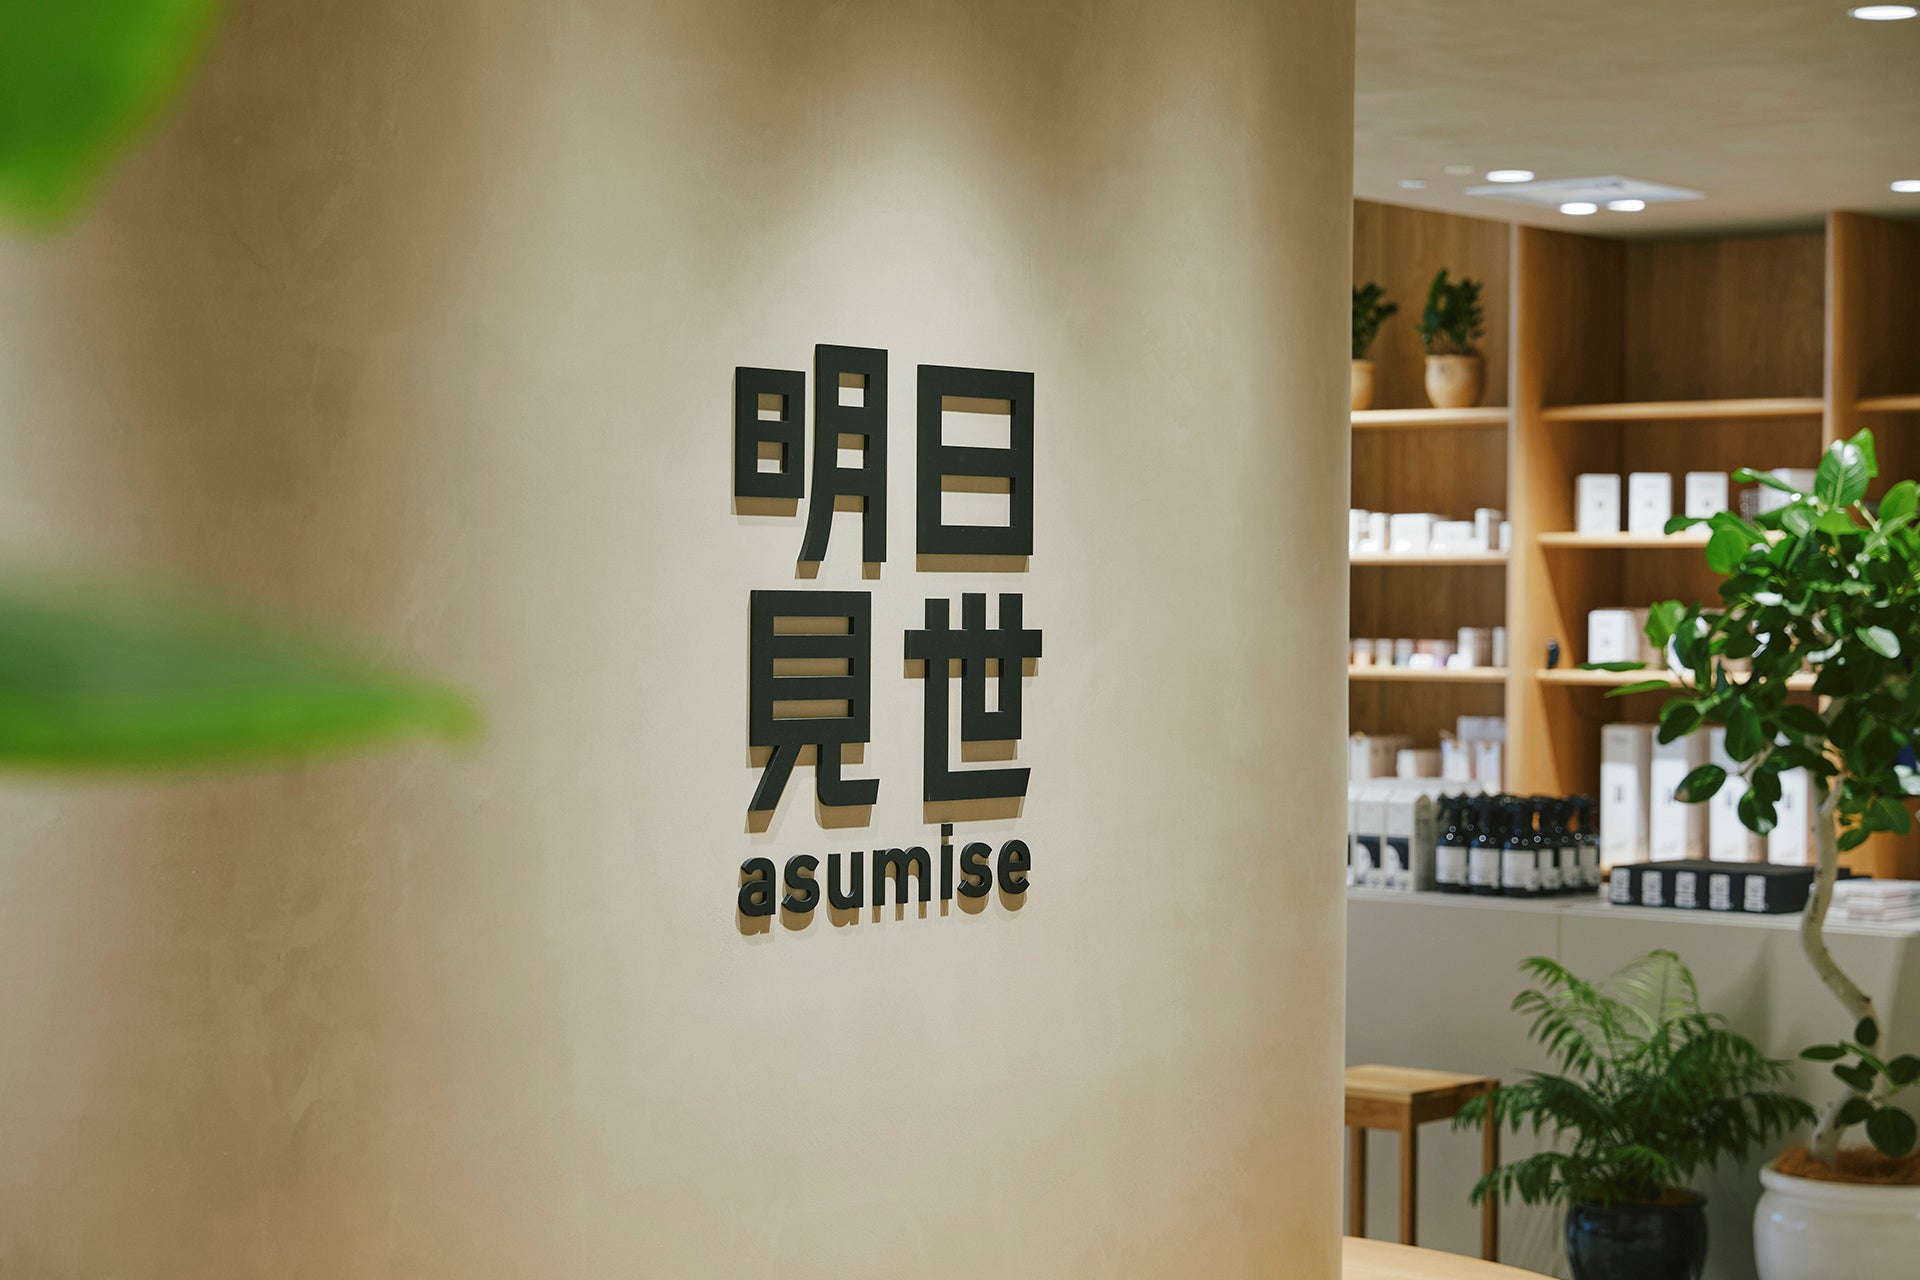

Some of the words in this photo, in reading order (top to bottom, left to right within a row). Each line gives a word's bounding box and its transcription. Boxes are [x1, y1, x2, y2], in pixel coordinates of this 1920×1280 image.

[734, 343, 1035, 563] 明日
[747, 589, 1043, 813] 見世
[737, 823, 1032, 918] asumise
